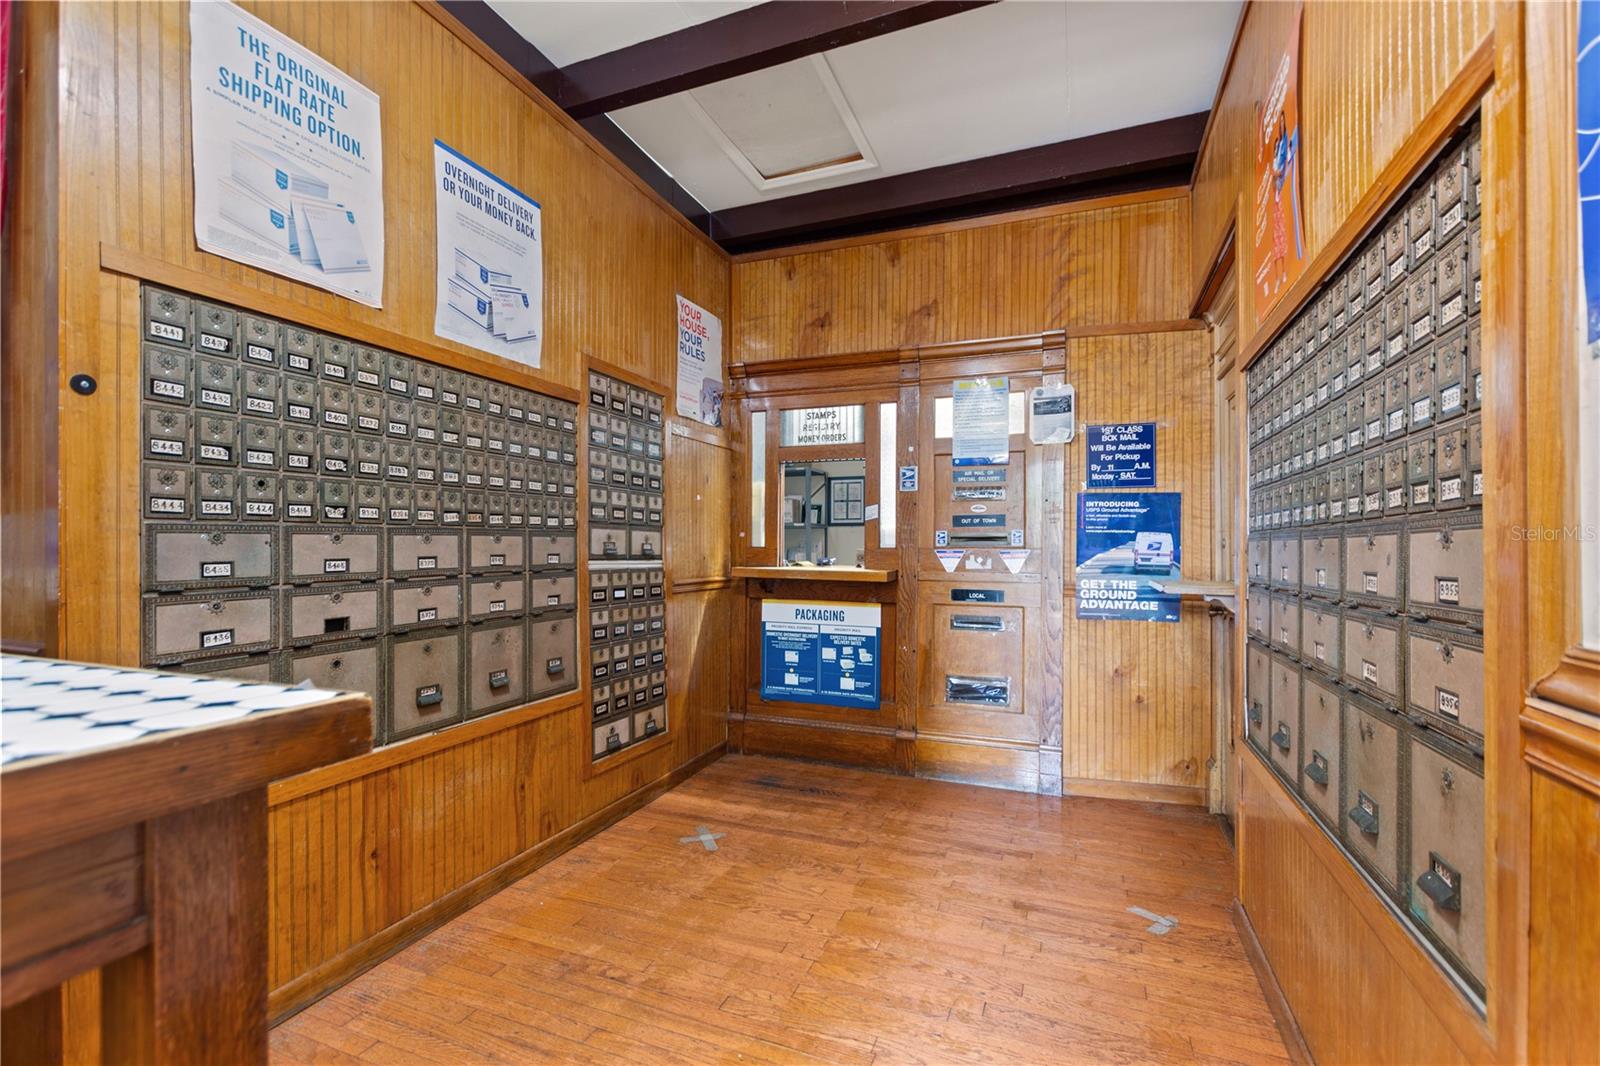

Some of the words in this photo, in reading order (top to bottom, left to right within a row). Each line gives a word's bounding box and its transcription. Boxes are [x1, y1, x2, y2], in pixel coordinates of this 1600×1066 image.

[237, 26, 271, 63] THE
[277, 52, 348, 109] ORIGINAL
[255, 61, 294, 98] FLAT
[299, 85, 336, 123] RATE
[219, 66, 302, 126] SHIPPING
[307, 115, 366, 160] OPTION.
[444, 161, 495, 202] OVERNIGHT
[498, 193, 534, 225] DELIVERY
[443, 177, 457, 197] OR
[459, 186, 483, 211] YOUR
[485, 200, 513, 228] MONEY
[515, 219, 537, 241] BACK.
[680, 300, 702, 321] YOUR
[155, 325, 179, 338] 8441
[680, 329, 703, 348] YOUR
[680, 341, 706, 362] RULES
[155, 382, 183, 396] 8442
[249, 400, 272, 410] 8422
[806, 411, 837, 420] STAMPS
[798, 435, 821, 444] MONEY
[821, 433, 847, 442] ORDERS
[1090, 444, 1104, 452] Will
[1118, 443, 1152, 451] Available
[1115, 453, 1140, 461] Pickup
[1091, 464, 1102, 472] By
[1091, 473, 1115, 481] Monday
[1441, 481, 1460, 497] 8954
[152, 500, 183, 508] 8444
[204, 503, 229, 511] 8434
[248, 504, 272, 513] 8424
[1080, 580, 1105, 589] GET
[1110, 580, 1137, 590] THE
[1440, 583, 1459, 597] 8955
[1080, 590, 1137, 600] GROUND
[1080, 600, 1159, 610] ADVANTAGE
[795, 608, 845, 622] PACKAGING
[205, 632, 230, 643] 8436
